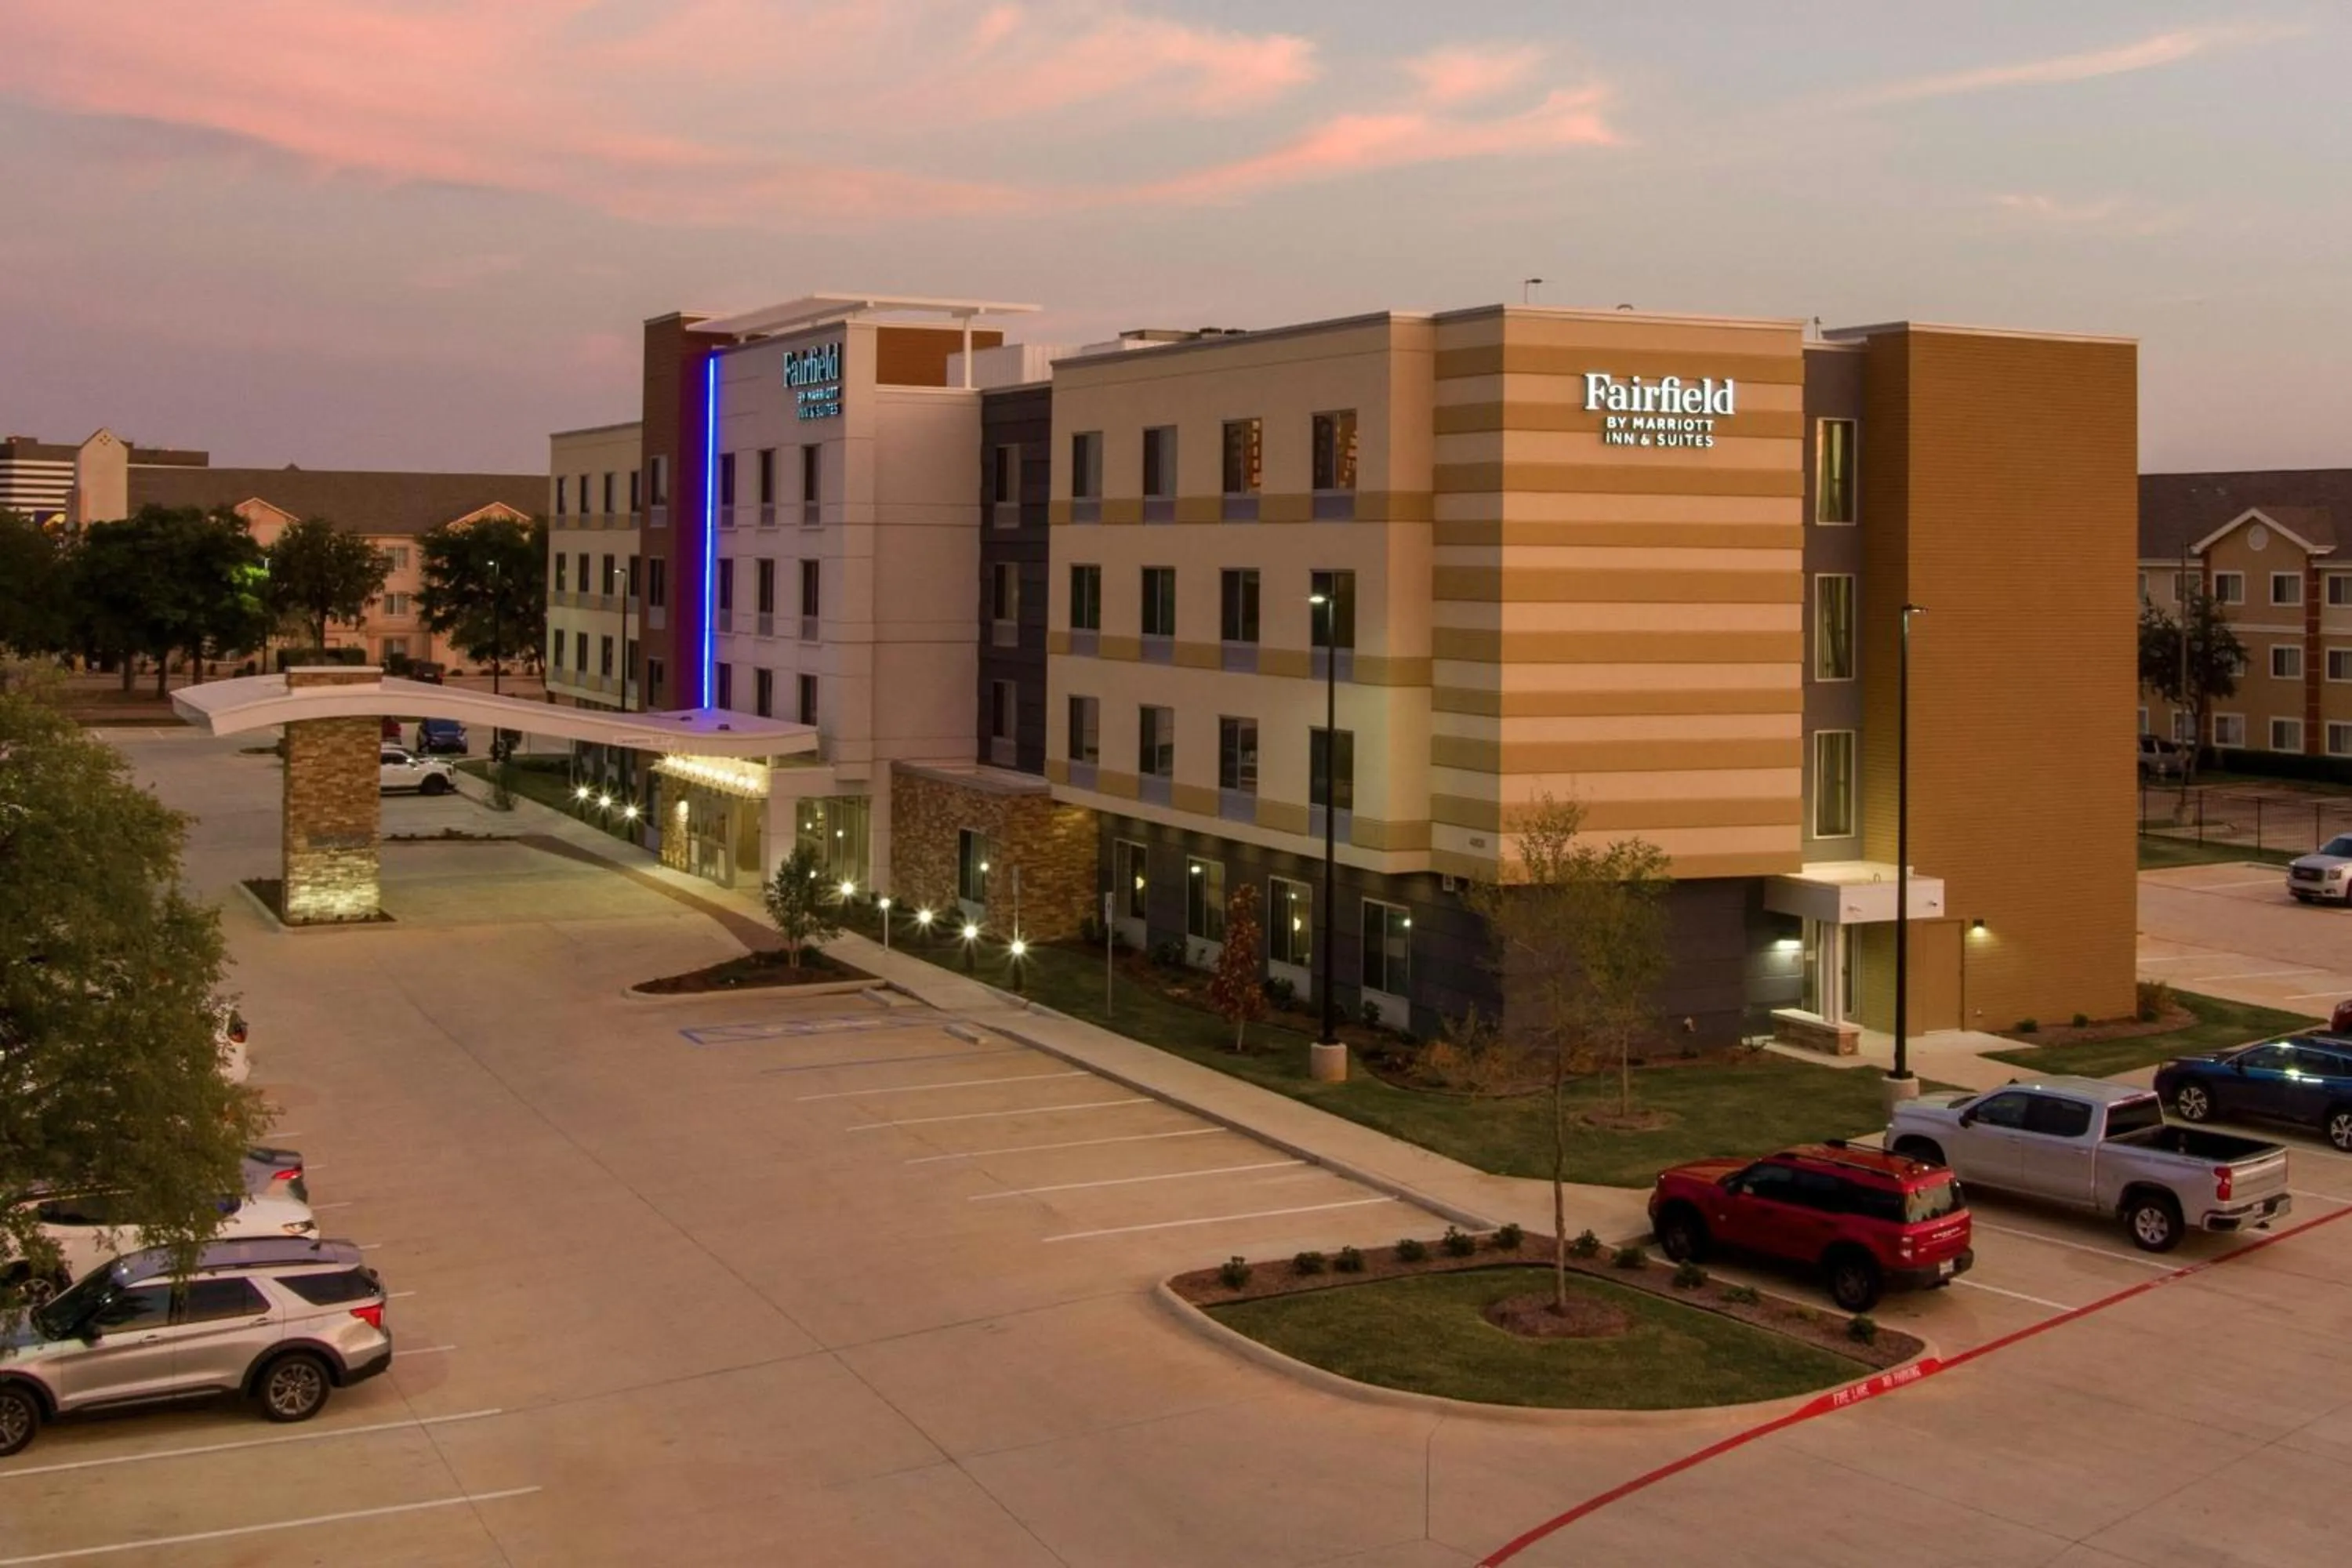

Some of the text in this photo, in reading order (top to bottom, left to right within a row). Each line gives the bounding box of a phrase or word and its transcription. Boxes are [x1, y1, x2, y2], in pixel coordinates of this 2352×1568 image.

[783, 342, 838, 388] Fairfield
[1584, 372, 1734, 415] Fairfield
[1607, 416, 1715, 431] BY MARRIOTT
[1606, 432, 1714, 447] INN & SUITES
